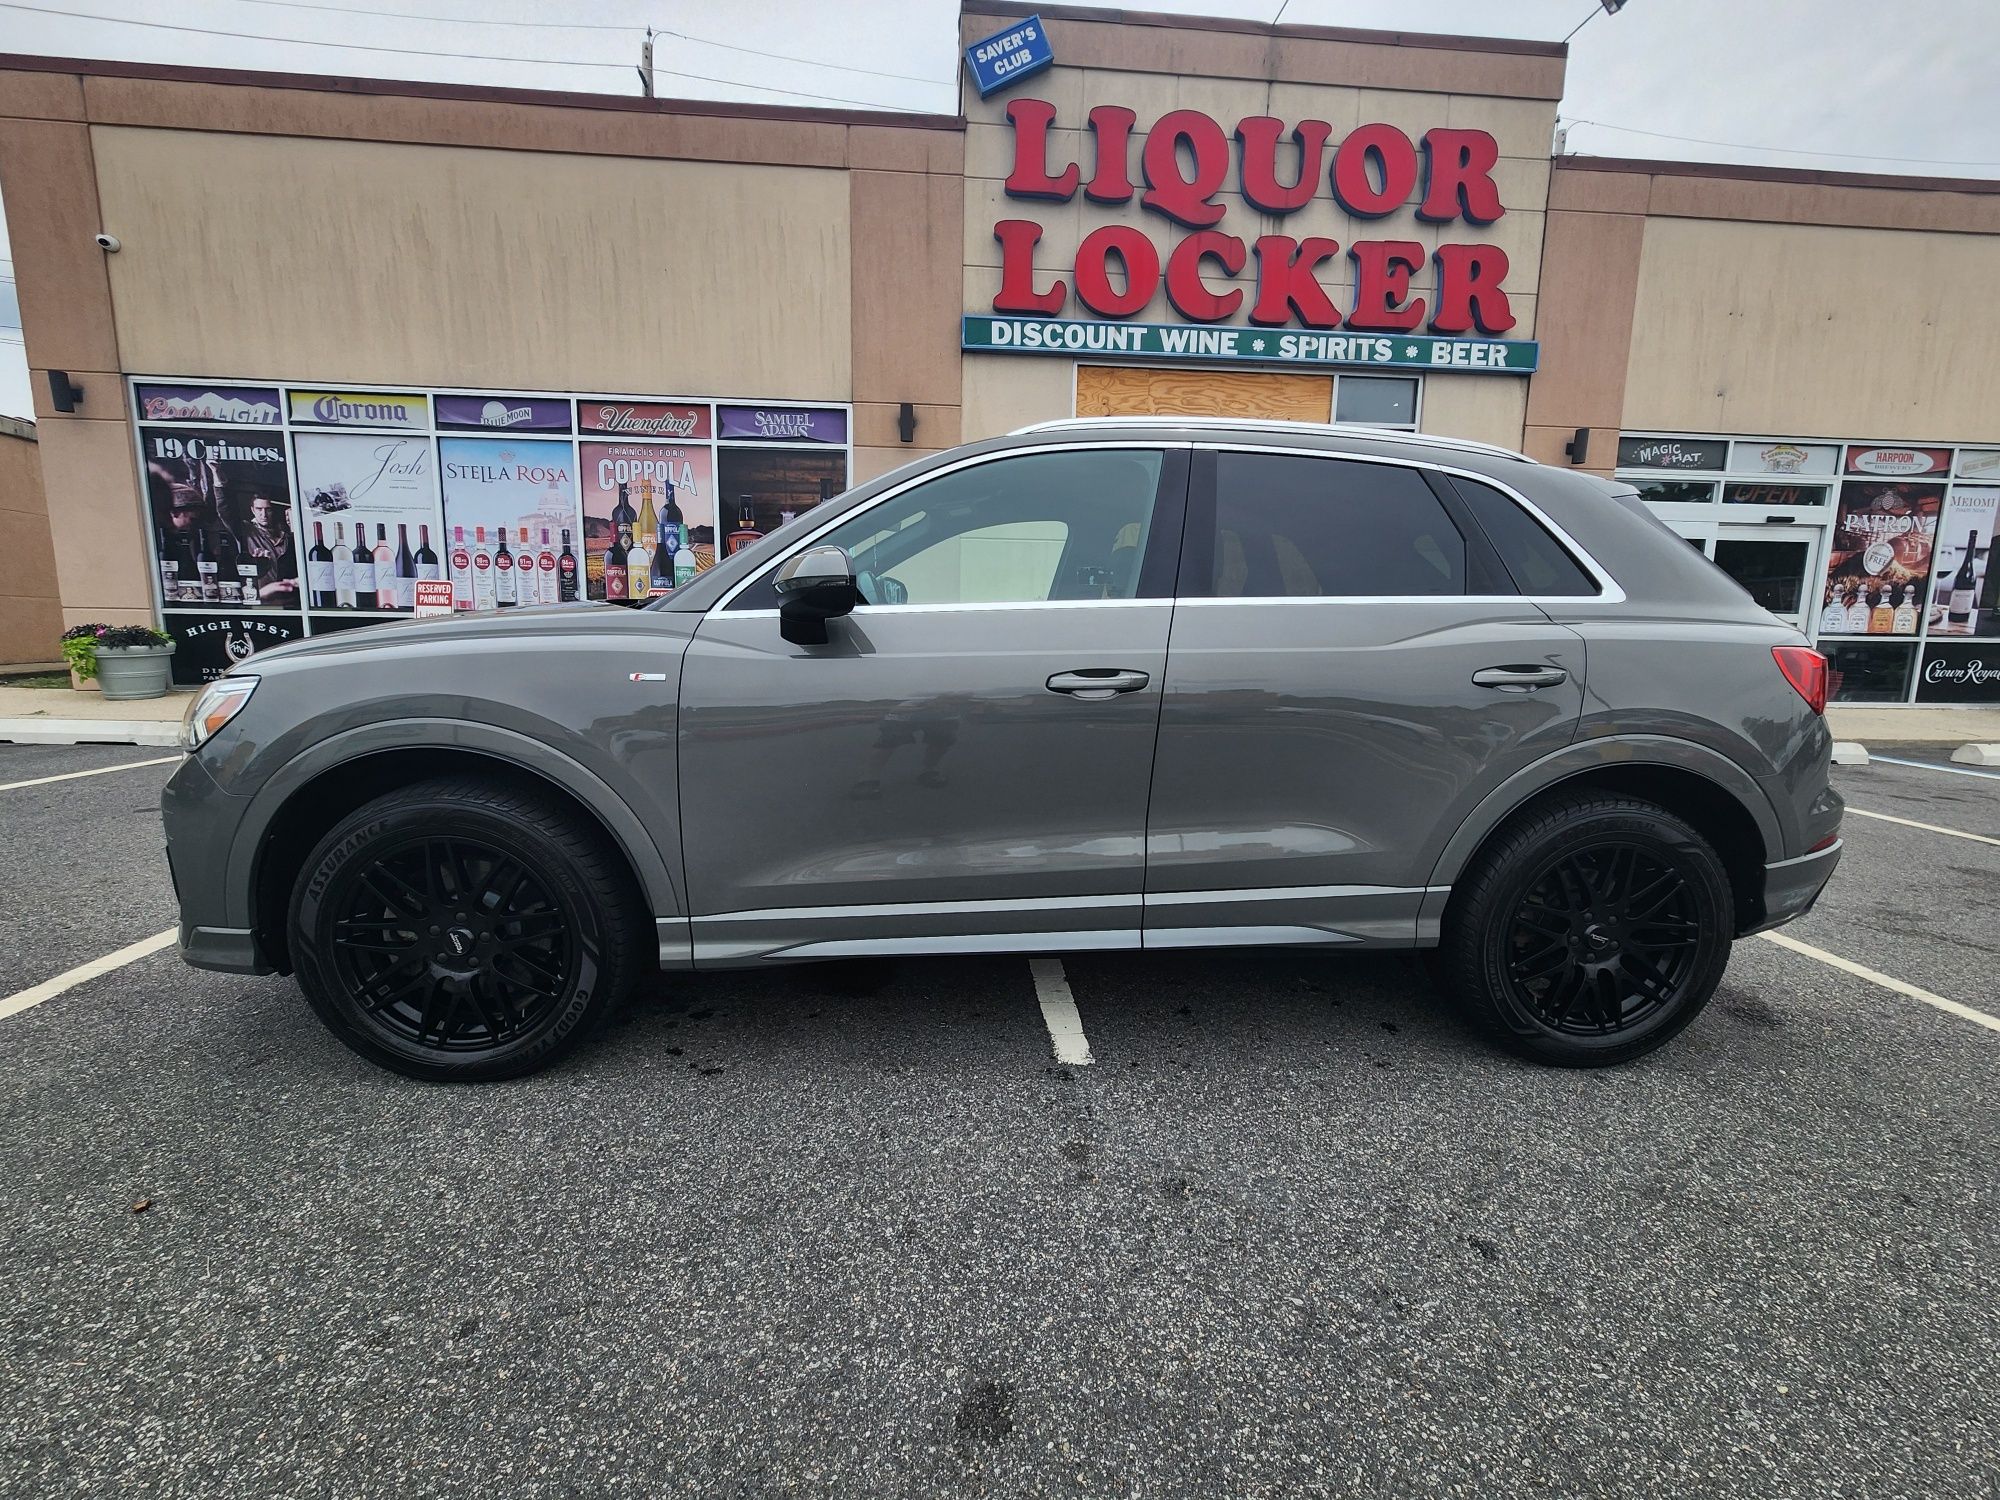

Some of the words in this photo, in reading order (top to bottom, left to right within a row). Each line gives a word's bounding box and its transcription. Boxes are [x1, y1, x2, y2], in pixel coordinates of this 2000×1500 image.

[976, 26, 1037, 63] SAVER'S
[994, 48, 1032, 75] CLUB
[1005, 99, 1507, 229] LIQUOR
[993, 220, 1516, 334] LOCKER
[991, 320, 1148, 350] DISCOUNT
[1159, 328, 1239, 355] WINE
[1278, 335, 1393, 362] SPIRITS
[1431, 341, 1509, 367] BEER
[213, 405, 280, 424] LIGHT
[313, 396, 409, 423] Corona
[506, 408, 531, 423] MOON
[755, 411, 814, 428] SAMUEL
[597, 406, 698, 437] Yuengling
[760, 425, 808, 437] ADAMS
[153, 438, 183, 459] 19
[608, 447, 654, 457] FRANCIS
[659, 449, 686, 458] FORD
[1639, 443, 1682, 463] MAGIC
[1671, 452, 1703, 463] HAT
[1876, 452, 1915, 464] HARPOON
[349, 441, 427, 500] Josh
[447, 463, 512, 484] STELLA
[517, 465, 570, 485] ROSA
[598, 458, 698, 497] COPPOLA
[1733, 486, 1800, 504] OPEN
[1950, 496, 1996, 507] MEIOMI
[418, 584, 451, 594] RESERVED
[420, 594, 449, 604] PARKING
[185, 620, 232, 638] HIGH
[241, 620, 290, 639] WEST
[1925, 659, 1965, 684] Crown
